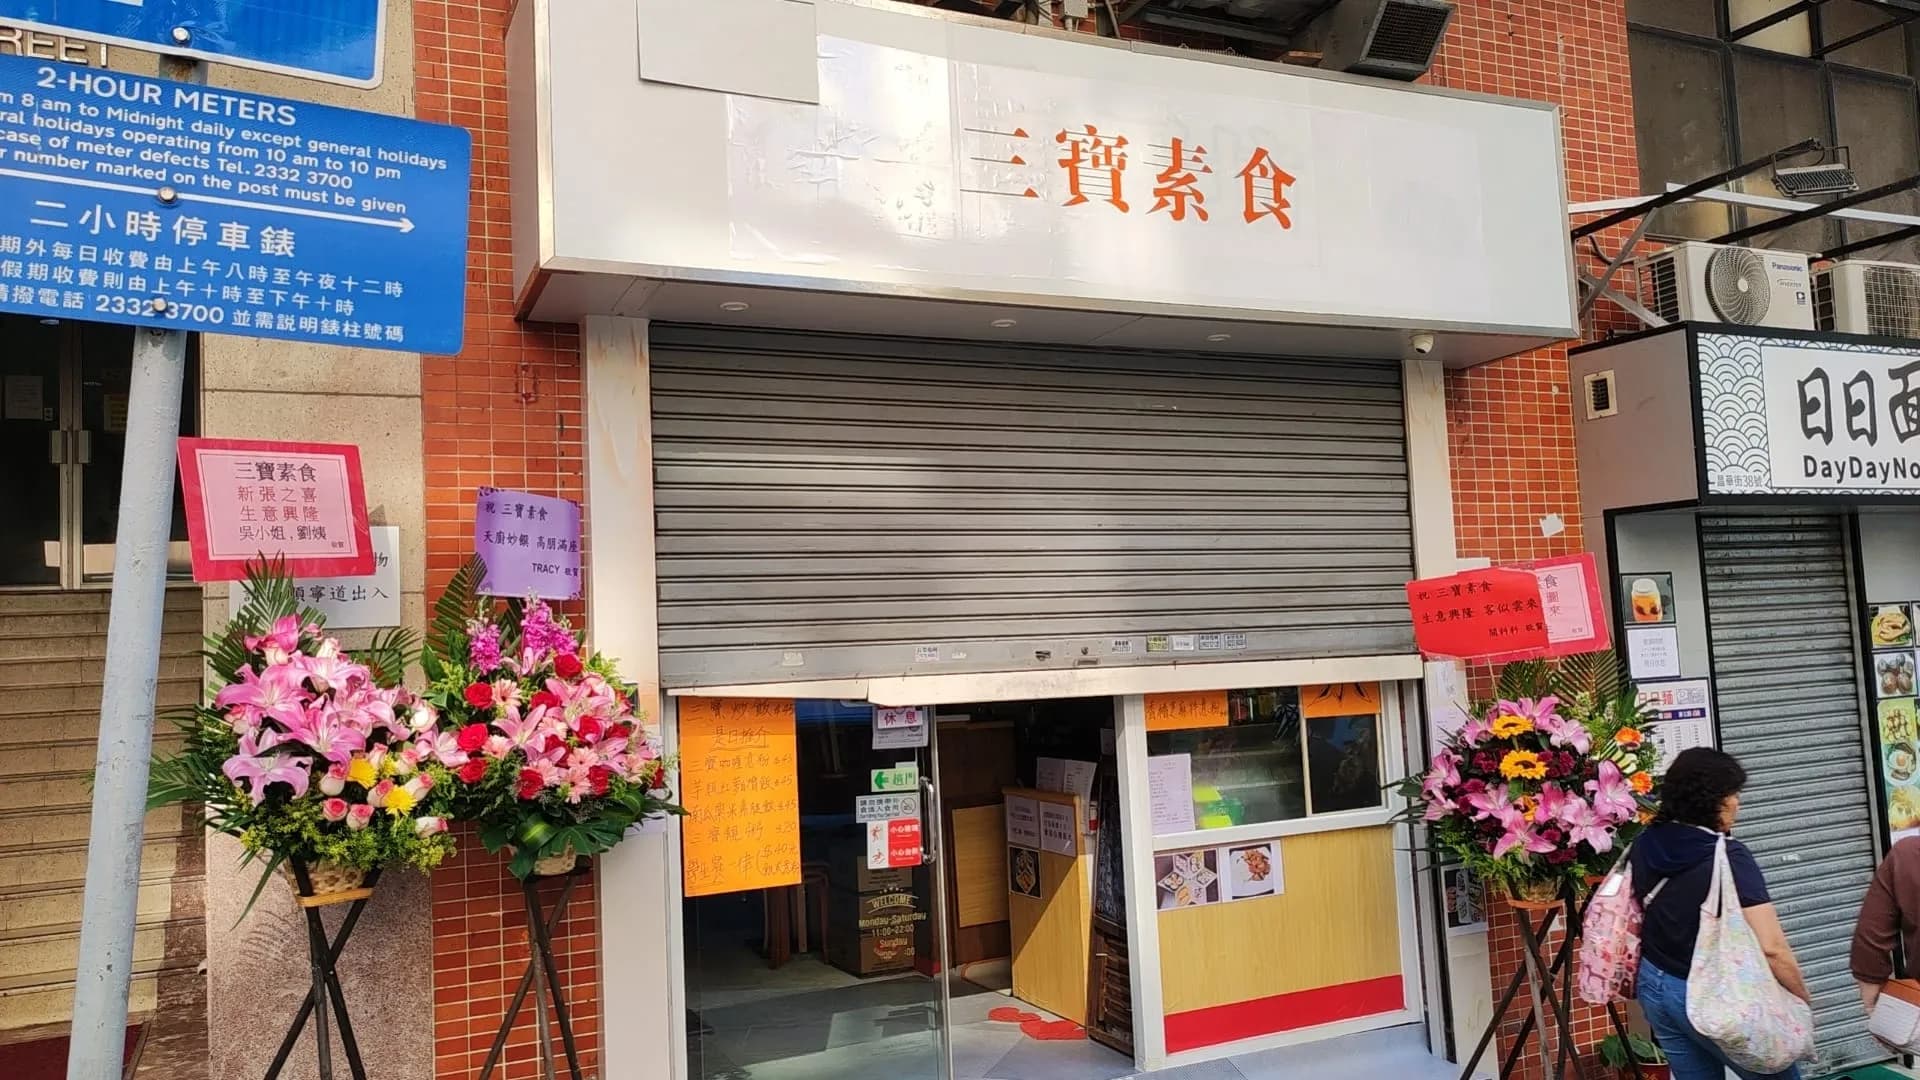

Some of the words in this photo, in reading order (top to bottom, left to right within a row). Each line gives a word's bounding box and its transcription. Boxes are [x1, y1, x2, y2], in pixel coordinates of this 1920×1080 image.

[37, 67, 161, 105] 2-HOUR
[173, 88, 296, 126] METERS
[21, 93, 35, 107] 8
[42, 98, 71, 113] am
[79, 102, 99, 117] to
[106, 107, 184, 131] Midnight
[191, 119, 235, 140] daily
[241, 128, 302, 148] except
[307, 139, 372, 159] general
[378, 148, 447, 171] holidays
[33, 113, 115, 138] holidays
[122, 128, 211, 155] operating
[217, 141, 259, 159] from
[266, 148, 286, 162] 10
[292, 153, 319, 168] am
[325, 157, 343, 171] to
[350, 161, 369, 175] 10
[375, 166, 401, 180] pm
[0, 129, 41, 145] case
[48, 136, 69, 149] of
[76, 140, 134, 158] meter
[139, 149, 210, 169] defects
[217, 158, 250, 175] Tel.
[254, 163, 300, 183] 2332
[307, 171, 353, 189] 3700
[14, 150, 89, 171] number
[95, 161, 167, 181] marked
[173, 172, 195, 184] on
[203, 174, 233, 191] the
[238, 182, 279, 197] post
[285, 188, 328, 204] must
[334, 191, 355, 207] be
[361, 198, 406, 214] given
[960, 124, 1297, 230] 三寶素食
[30, 200, 296, 258] 二小時停車錶
[95, 294, 155, 317] 2332
[166, 301, 224, 325] 3700
[233, 461, 316, 482] 三寶素食
[237, 486, 317, 503] 新張之喜
[240, 505, 320, 523] 生意興隆
[485, 502, 496, 514] 祝
[501, 503, 548, 521] 三寶素食
[537, 536, 578, 553] 高朋滿座
[532, 563, 560, 575] TRACY
[1416, 590, 1430, 601] 祝
[1436, 580, 1494, 599] 三寶素食
[1422, 607, 1475, 625] 生意興隆
[1484, 599, 1539, 617] 客似雲來
[884, 711, 917, 726] 休息
[872, 895, 913, 909] WELCOME
